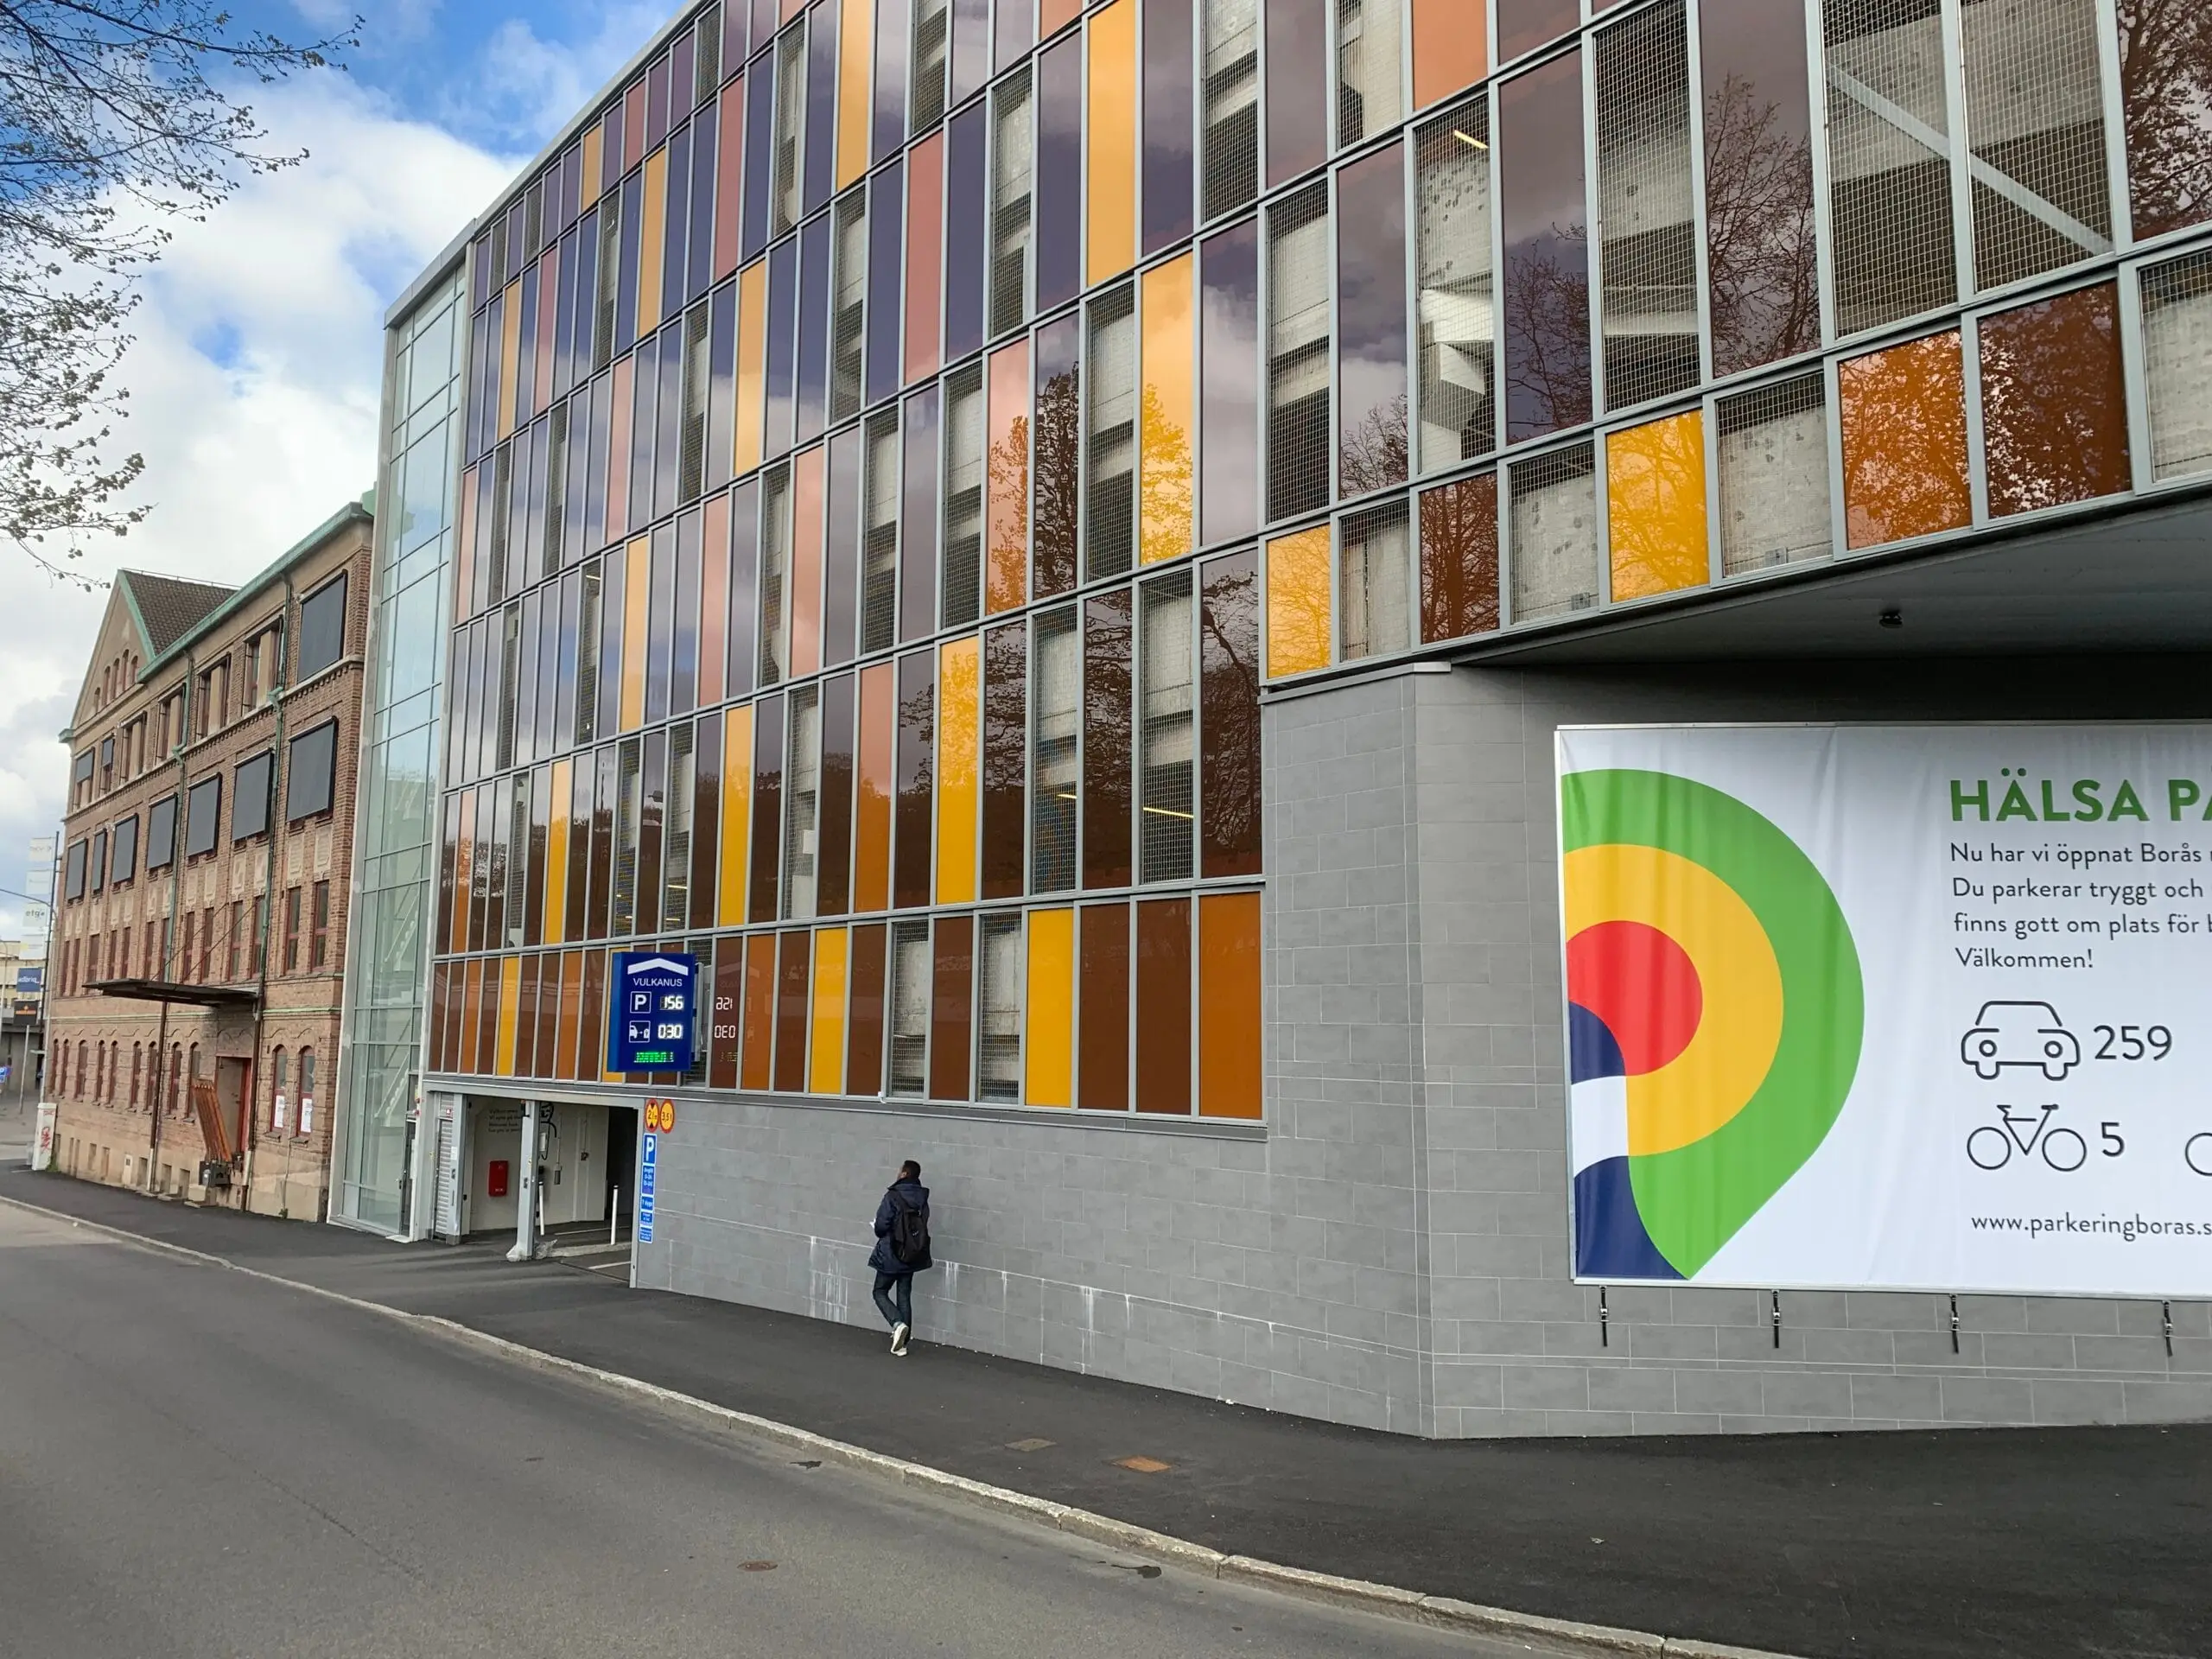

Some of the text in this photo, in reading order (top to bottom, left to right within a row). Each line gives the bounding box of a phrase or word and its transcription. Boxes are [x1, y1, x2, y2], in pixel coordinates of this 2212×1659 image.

[1950, 767, 2212, 822] HÄLSA P
[1950, 842, 1983, 862] Nu
[1990, 842, 2025, 862] har
[2031, 842, 2050, 862] vi
[2056, 842, 2133, 870] öppnat
[2140, 842, 2202, 863] Borås
[1952, 877, 2203, 906] Du parkerar tryggt och
[1953, 912, 2007, 932] finns
[2014, 917, 2060, 941] gott
[2066, 920, 2101, 933] om
[2108, 912, 2160, 941] plats
[2166, 912, 2200, 934] för
[1954, 946, 2094, 969] Välkommen!
[633, 977, 683, 988] VULKANUS
[658, 1024, 683, 1039] 030
[2093, 1025, 2173, 1062] 259
[645, 1136, 655, 1161] P
[2101, 1122, 2126, 1158] 5
[1971, 1211, 2212, 1242] www.parkeringboras.s
